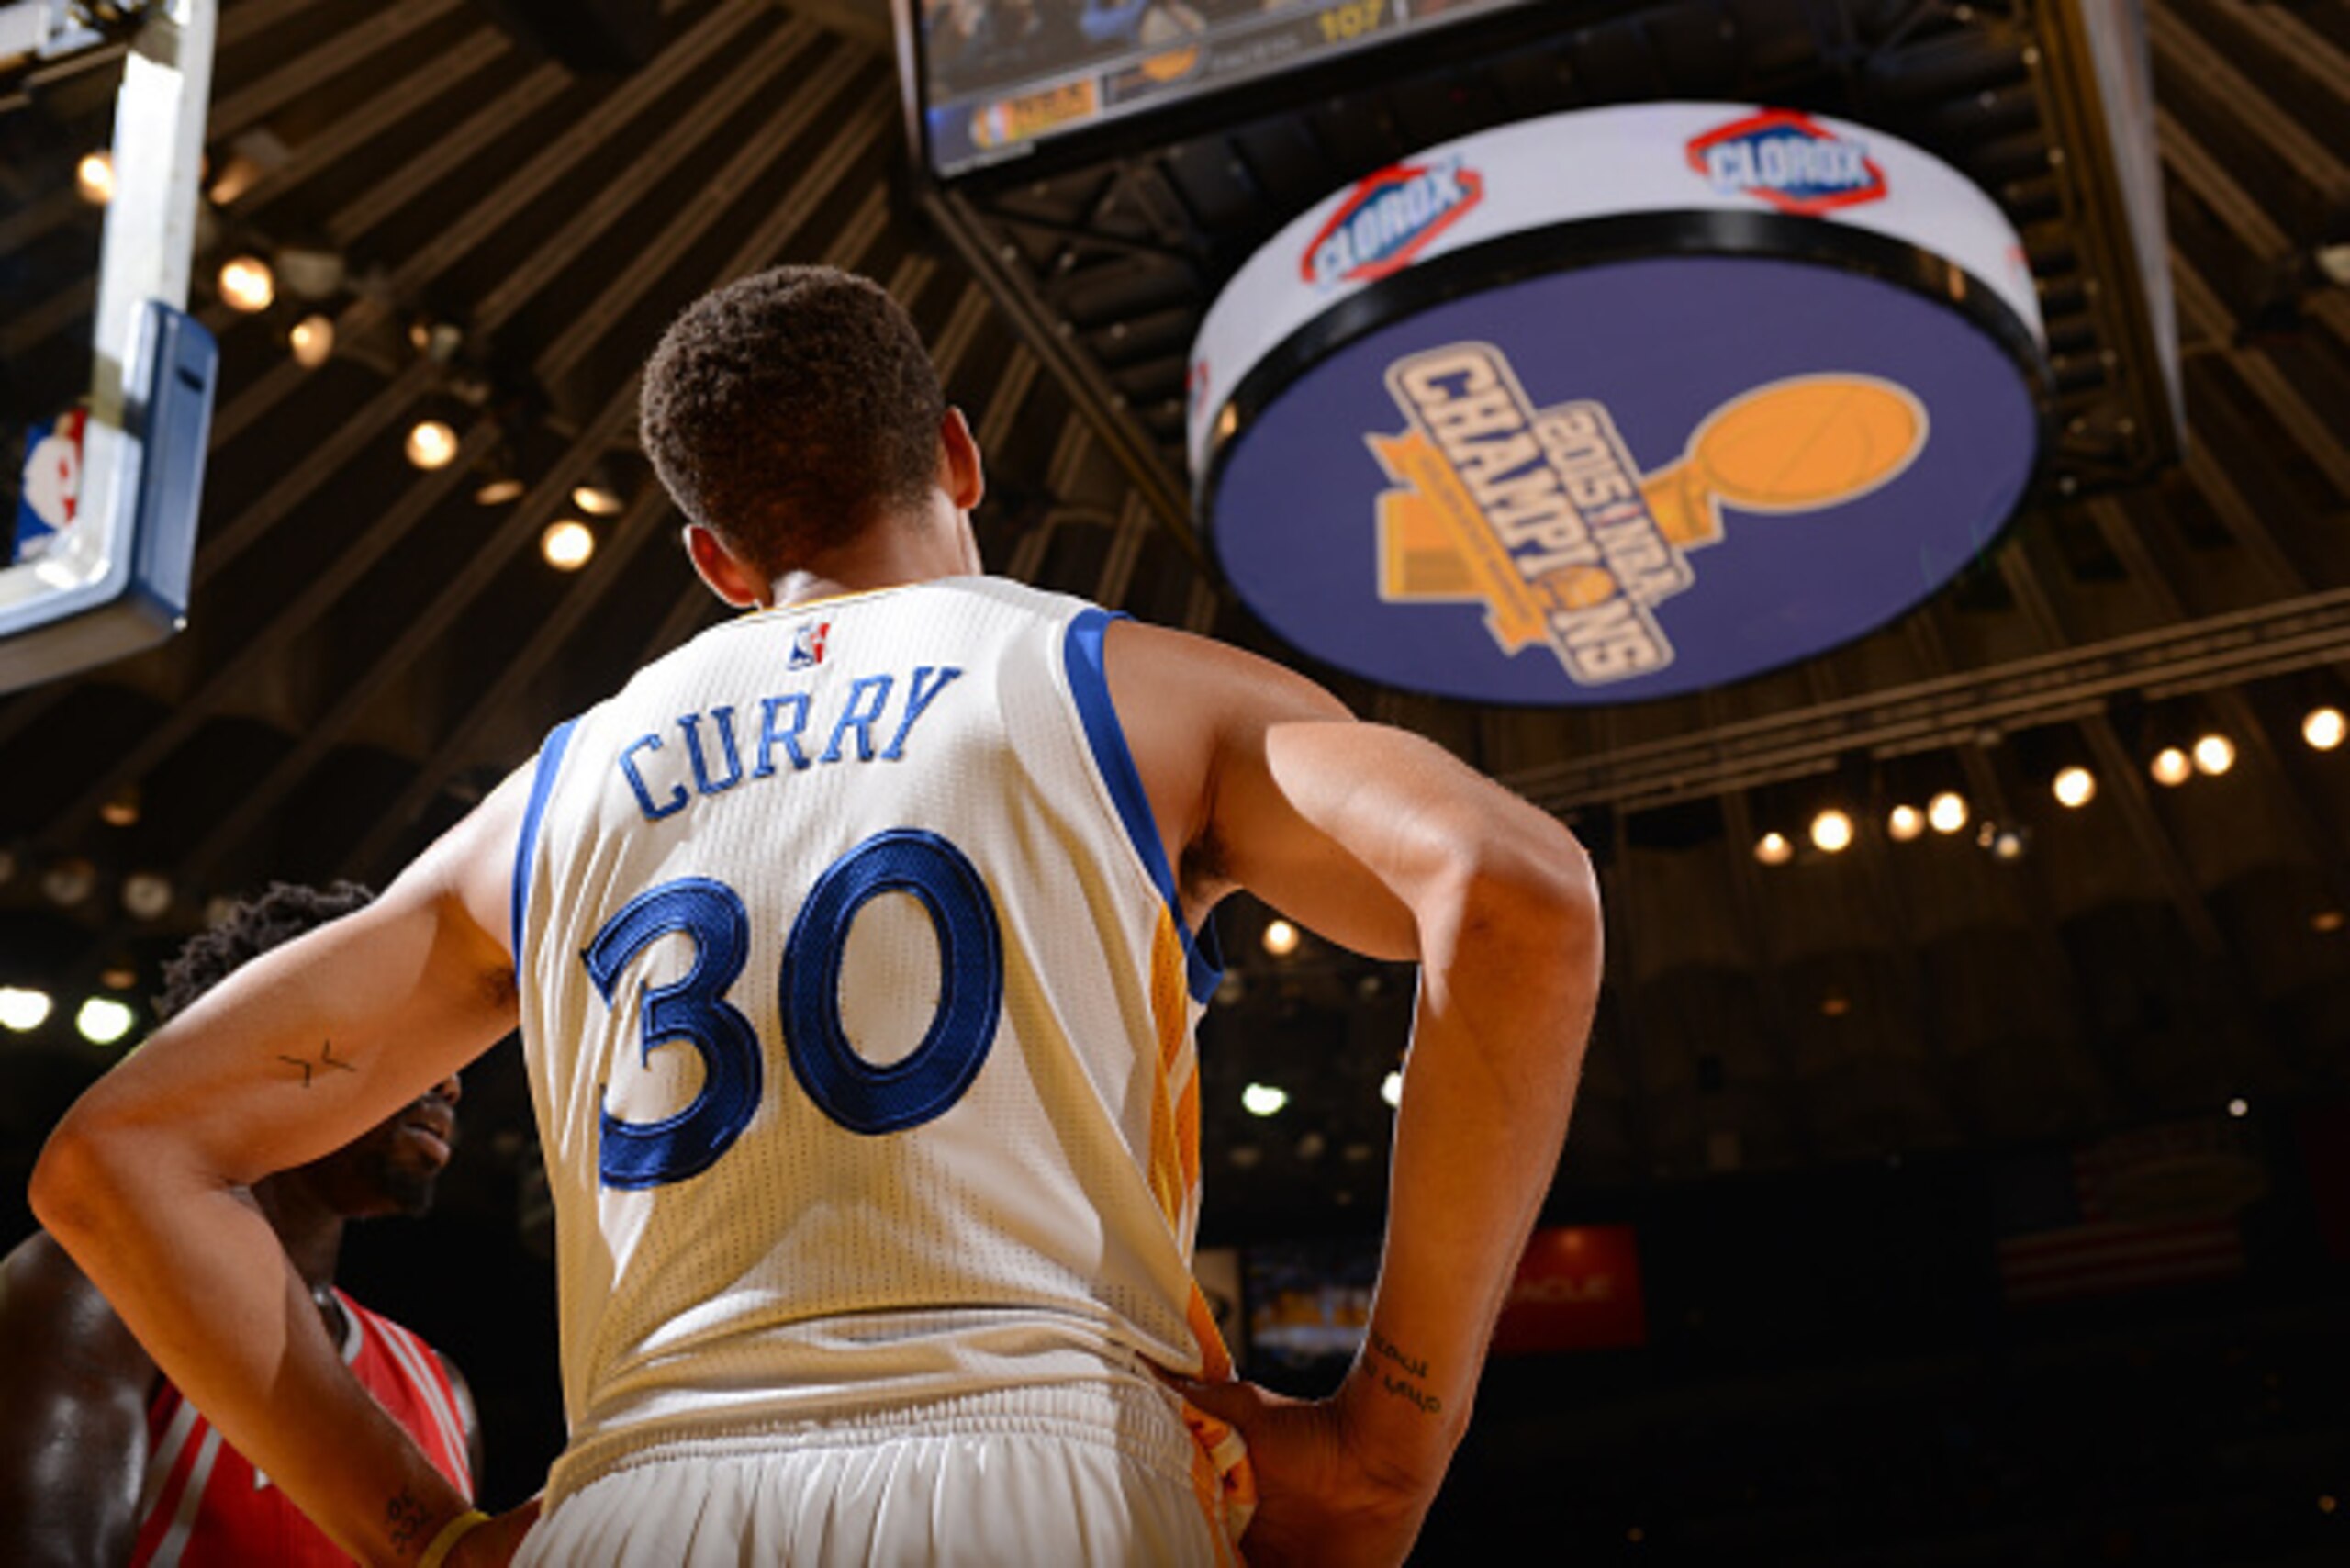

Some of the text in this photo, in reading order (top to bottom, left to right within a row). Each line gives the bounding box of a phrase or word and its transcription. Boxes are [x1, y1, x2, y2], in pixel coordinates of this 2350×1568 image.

[1319, 0, 1384, 44] 107
[1315, 160, 1465, 283] CLOROX
[1706, 136, 1869, 191] CLOROX
[1401, 353, 1668, 678] CHAMPIONS
[1534, 409, 1685, 602] 2015 NBA
[619, 666, 962, 822] CURRY
[580, 827, 1003, 1191] 30
